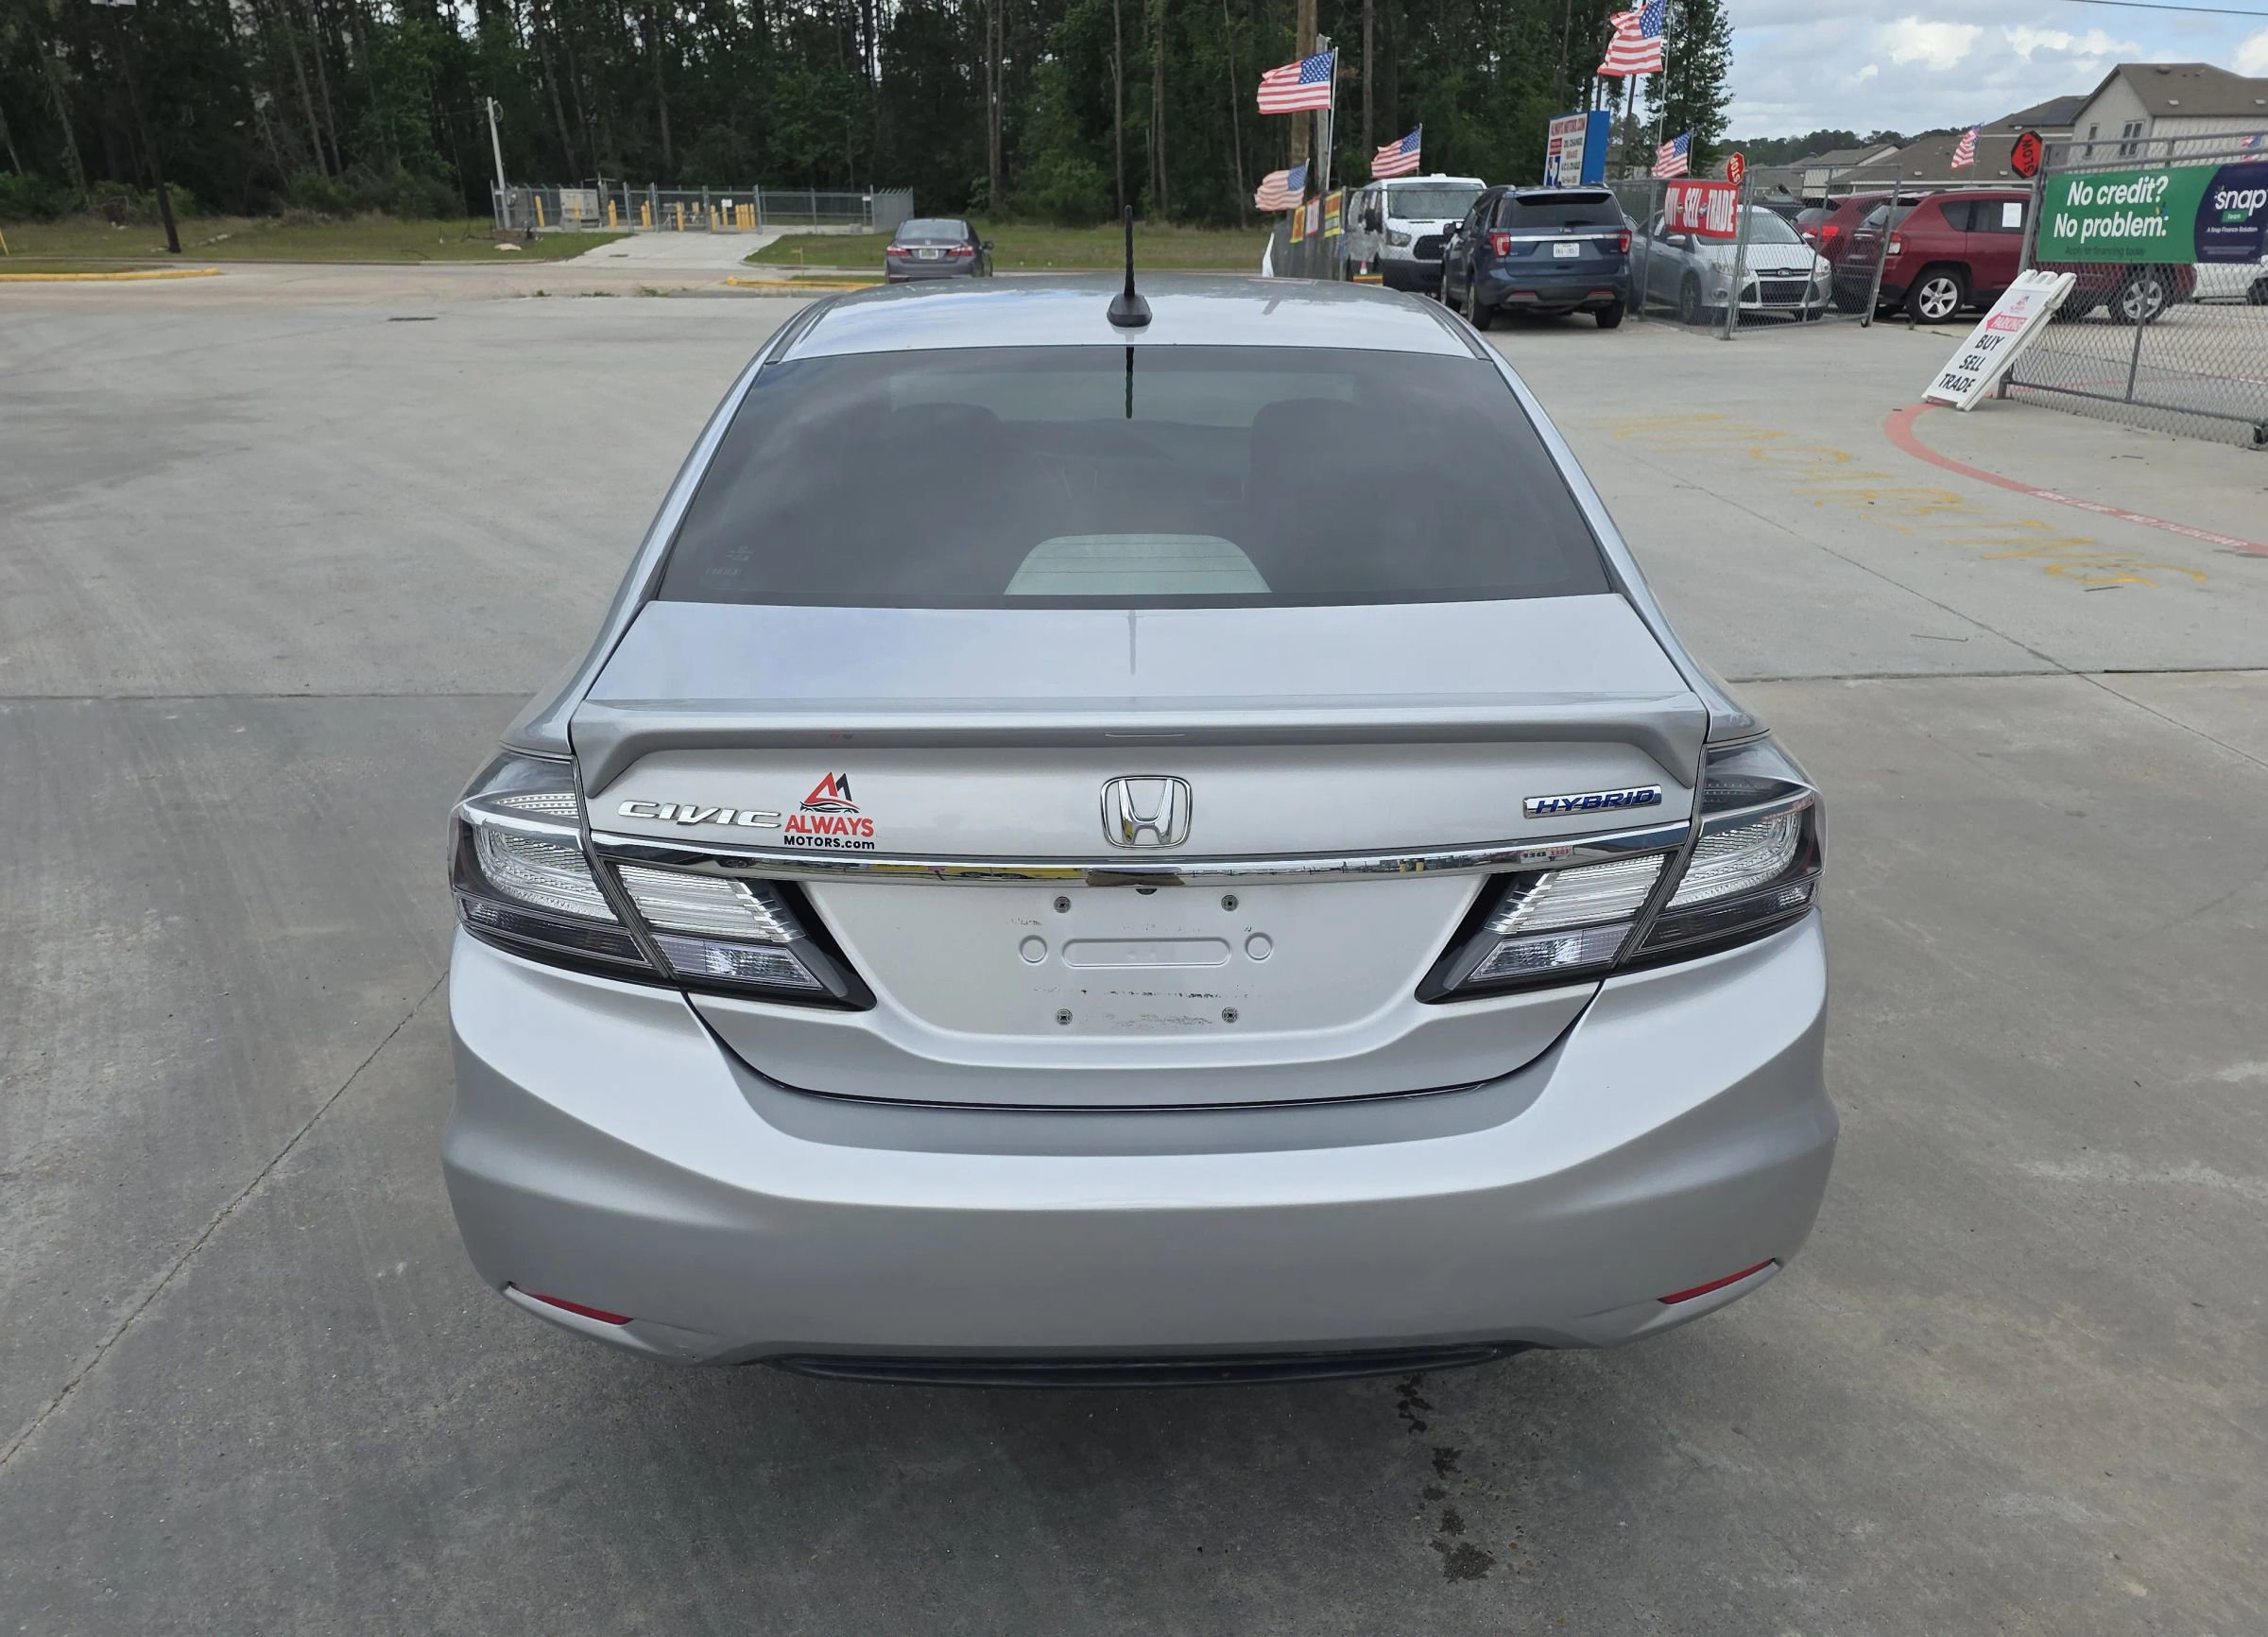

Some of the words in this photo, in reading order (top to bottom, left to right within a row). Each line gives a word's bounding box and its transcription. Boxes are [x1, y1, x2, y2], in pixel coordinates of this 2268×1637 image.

[2021, 139, 2035, 173] SLOW
[1729, 157, 1741, 183] STOP
[2067, 181, 2094, 206] No
[2096, 175, 2169, 205] credit?
[2214, 189, 2267, 216] snap
[1683, 187, 1703, 228] SELL
[1706, 189, 1737, 233] TRADE
[2053, 212, 2078, 238] No
[1975, 334, 2005, 351] BUY
[1958, 354, 1986, 371] SELL
[1938, 373, 1976, 393] TRADE
[618, 800, 782, 828] CIVIC
[1535, 788, 1656, 815] HYBRID
[784, 814, 874, 837] ALWAYS
[783, 835, 875, 850] MOTORS.com
